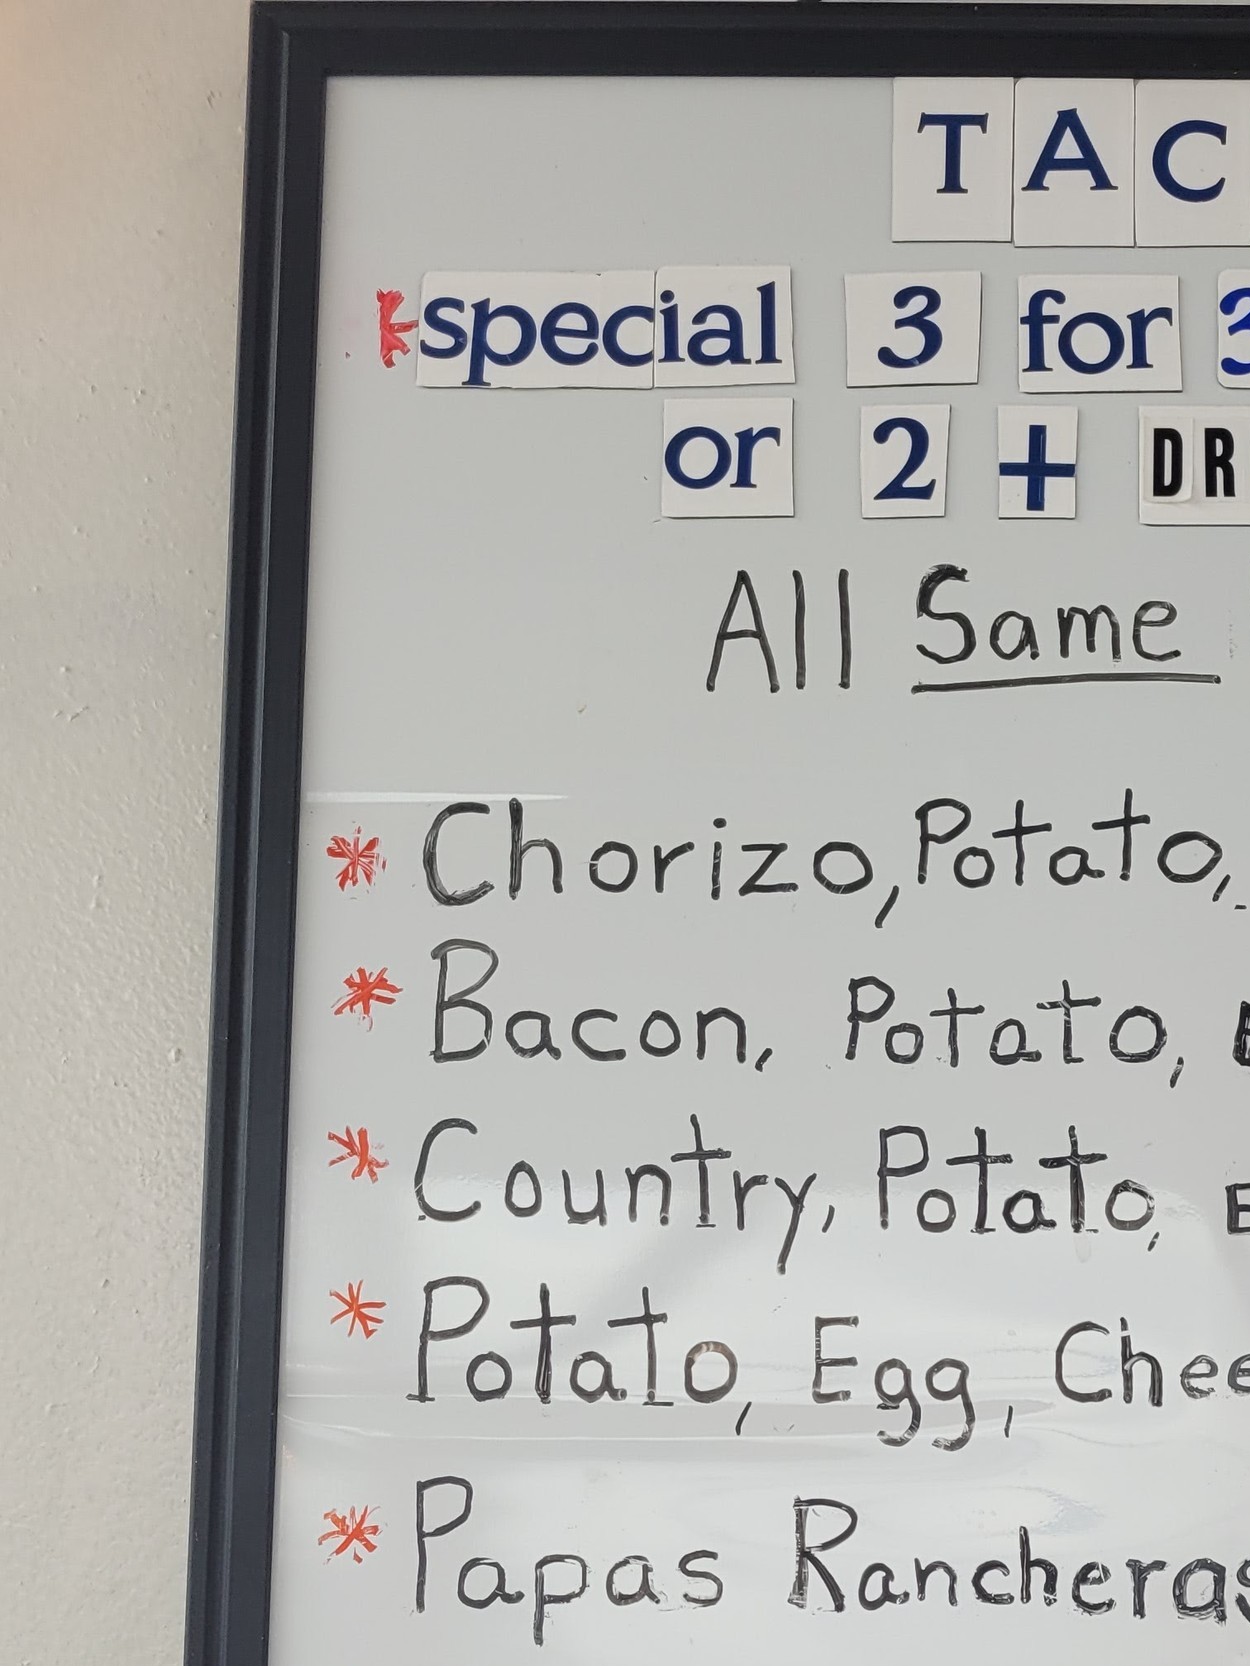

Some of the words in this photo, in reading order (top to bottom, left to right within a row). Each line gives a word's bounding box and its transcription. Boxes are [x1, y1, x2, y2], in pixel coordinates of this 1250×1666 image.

[418, 281, 784, 387] special
[876, 284, 944, 370] 3
[1018, 288, 1174, 376] for
[663, 425, 782, 491] or
[872, 416, 938, 502] 2
[1000, 423, 1075, 513] +
[705, 567, 853, 695] All
[915, 562, 1184, 655] Same
[421, 796, 901, 930] Chorizo,
[428, 937, 774, 1074] Bacon,
[844, 974, 1183, 1090] Potato,
[413, 1112, 836, 1275] Country,
[875, 1124, 1163, 1252] Potato,
[405, 1275, 753, 1437] Potato,
[811, 1315, 1015, 1453] Egg,
[414, 1474, 724, 1647] Papas
